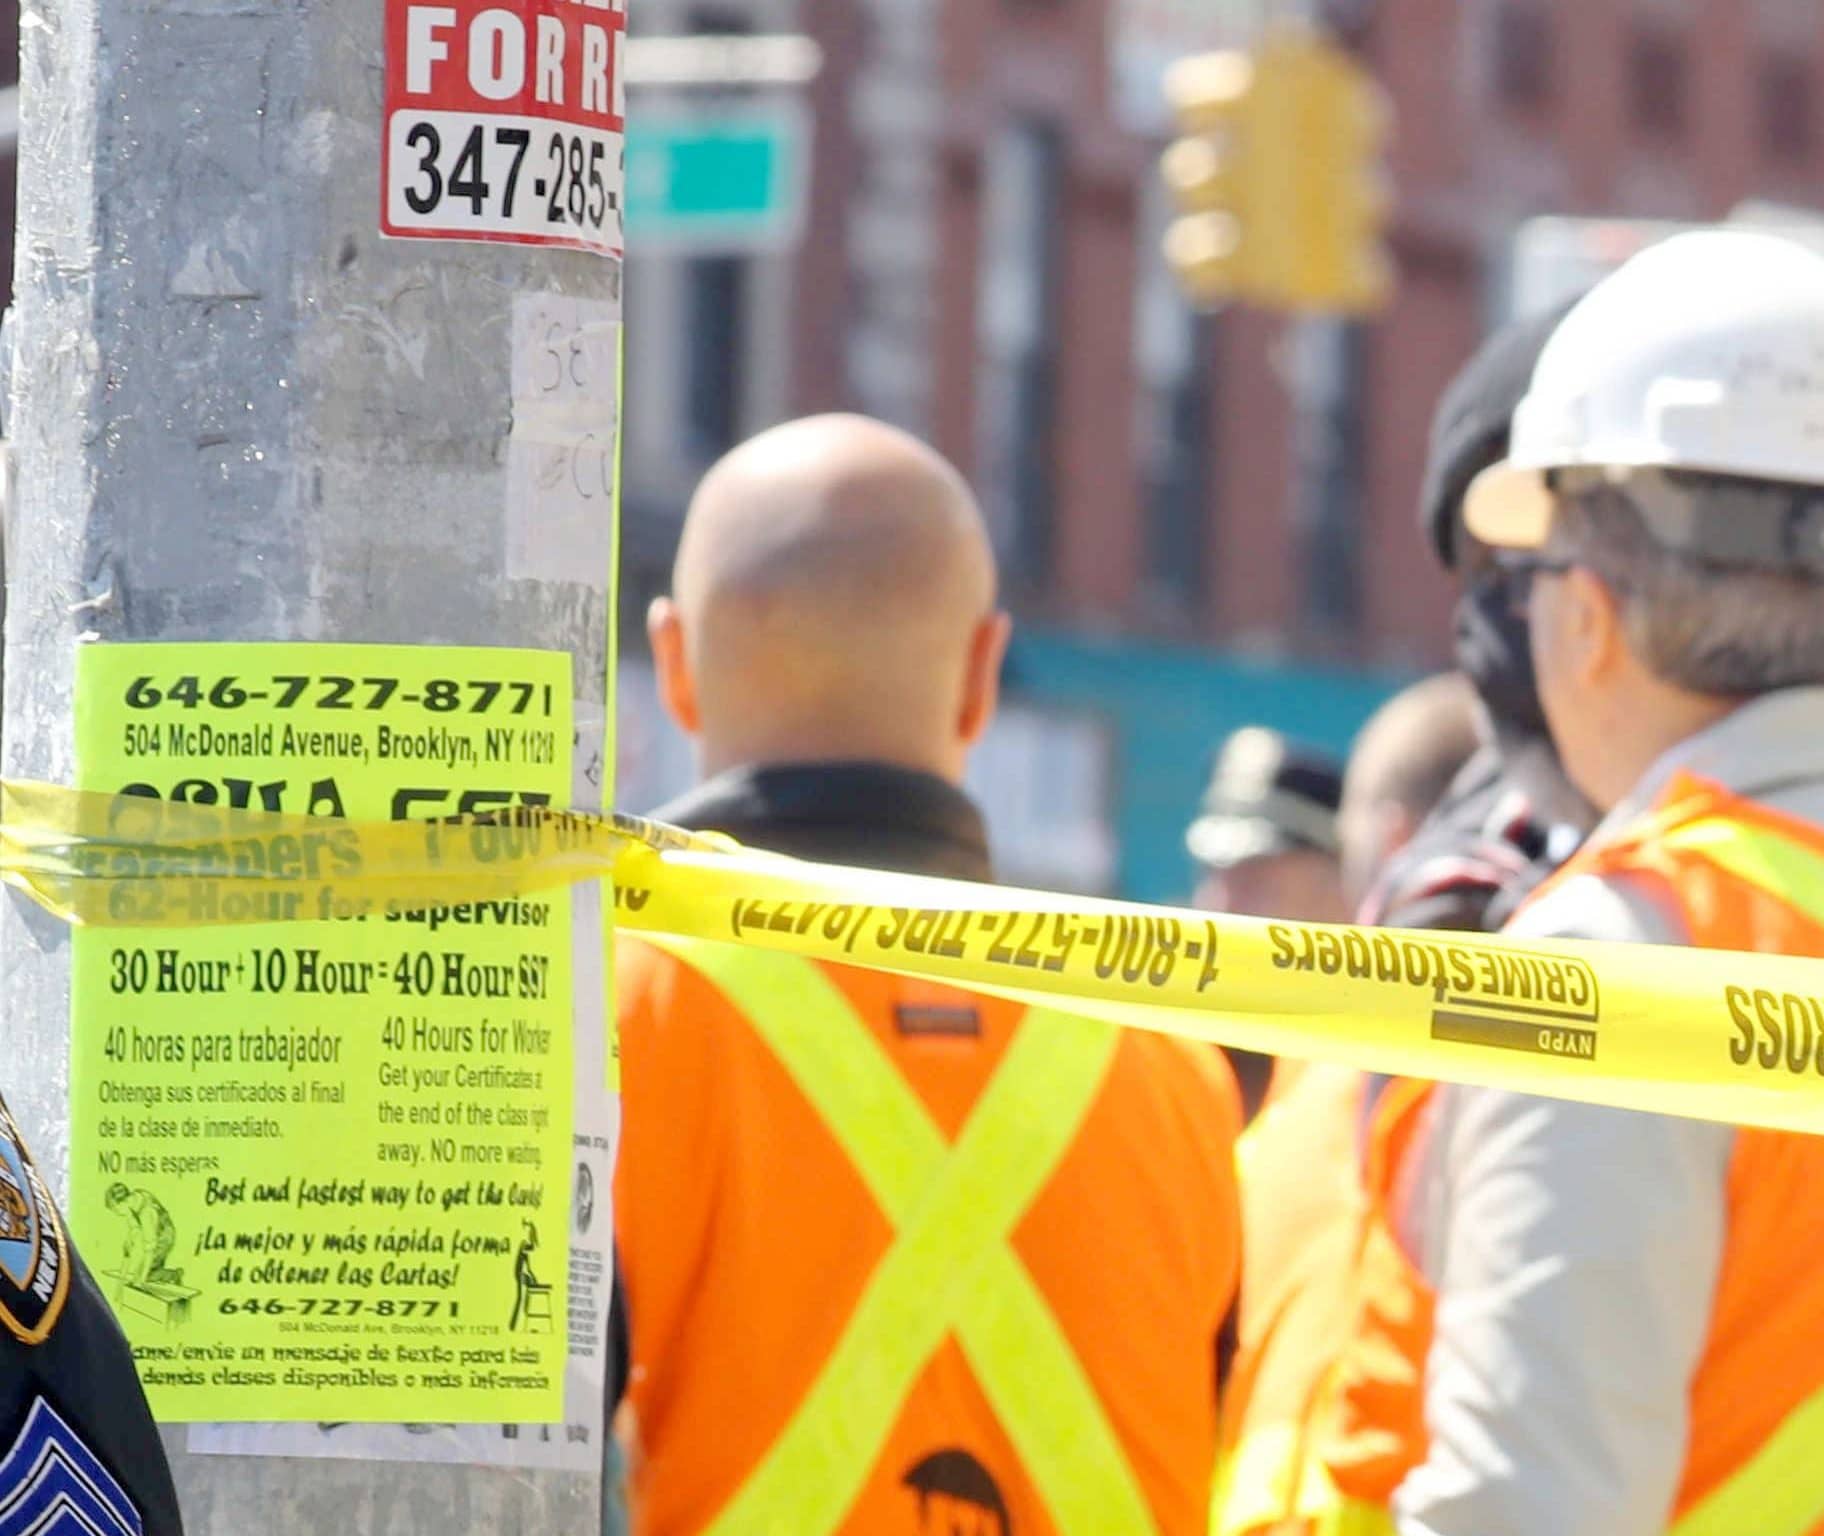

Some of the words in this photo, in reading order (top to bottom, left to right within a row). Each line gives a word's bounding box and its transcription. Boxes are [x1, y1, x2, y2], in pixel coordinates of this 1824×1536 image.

[406, 5, 565, 105] FOR
[404, 122, 624, 232] 347-285-
[125, 676, 551, 717] 646-727-8771
[125, 723, 160, 756] 504
[168, 723, 272, 757] McDonald
[280, 723, 369, 765] Avenue,
[378, 725, 478, 769] Brooklyn,
[486, 728, 514, 762] NY
[111, 948, 148, 994] 30
[156, 949, 230, 994] Hour
[251, 948, 286, 994] 10
[294, 949, 373, 995] Hour
[394, 951, 434, 997] 40
[441, 953, 514, 998] Hour
[105, 1026, 126, 1062] 40
[133, 1025, 185, 1062] horas
[192, 1035, 233, 1072] para
[239, 1025, 342, 1071] trabajador
[382, 1016, 405, 1051] 40
[412, 1017, 472, 1052] Hours
[480, 1018, 508, 1053] for
[1538, 1029, 1592, 1056] NYPD
[378, 1062, 407, 1087] Get
[412, 1065, 450, 1092] your
[455, 1063, 532, 1089] Certificates
[99, 1080, 162, 1108] Obtenga
[167, 1084, 192, 1103] sus
[198, 1080, 286, 1103] certificados
[291, 1080, 305, 1103] al
[310, 1080, 345, 1103] final
[99, 1116, 116, 1138] de
[121, 1116, 134, 1138] la
[139, 1116, 177, 1138] clase
[182, 1116, 200, 1138] de
[378, 1101, 403, 1124] the
[408, 1102, 440, 1125] end
[445, 1102, 463, 1125] of
[467, 1103, 493, 1126] the
[497, 1104, 528, 1127] class
[98, 1150, 121, 1174] NO
[126, 1151, 157, 1174] más
[377, 1142, 425, 1169] away.
[431, 1138, 456, 1163] NO
[461, 1144, 503, 1164] more
[206, 1176, 245, 1207] Best
[253, 1176, 290, 1203] and
[297, 1177, 365, 1209] fastest
[371, 1186, 410, 1211] way
[416, 1180, 435, 1204] to
[442, 1181, 470, 1212] get
[478, 1180, 503, 1205] the
[235, 1226, 294, 1256] mejor
[302, 1233, 315, 1256] y
[323, 1225, 367, 1254] más
[375, 1225, 444, 1258] rápida
[451, 1228, 511, 1259] forma
[32, 1240, 59, 1303] NEW
[218, 1258, 243, 1284] de
[250, 1257, 329, 1285] obtener
[337, 1260, 373, 1288] las
[381, 1261, 460, 1289] Cartas!
[219, 1298, 459, 1318] 646-727-8771
[131, 1341, 235, 1362] ame/envie
[273, 1343, 361, 1365] mensaje
[367, 1344, 390, 1363] de
[397, 1344, 454, 1364] texto
[460, 1347, 504, 1367] para
[212, 1366, 276, 1386] clases
[282, 1367, 398, 1389] disponibles
